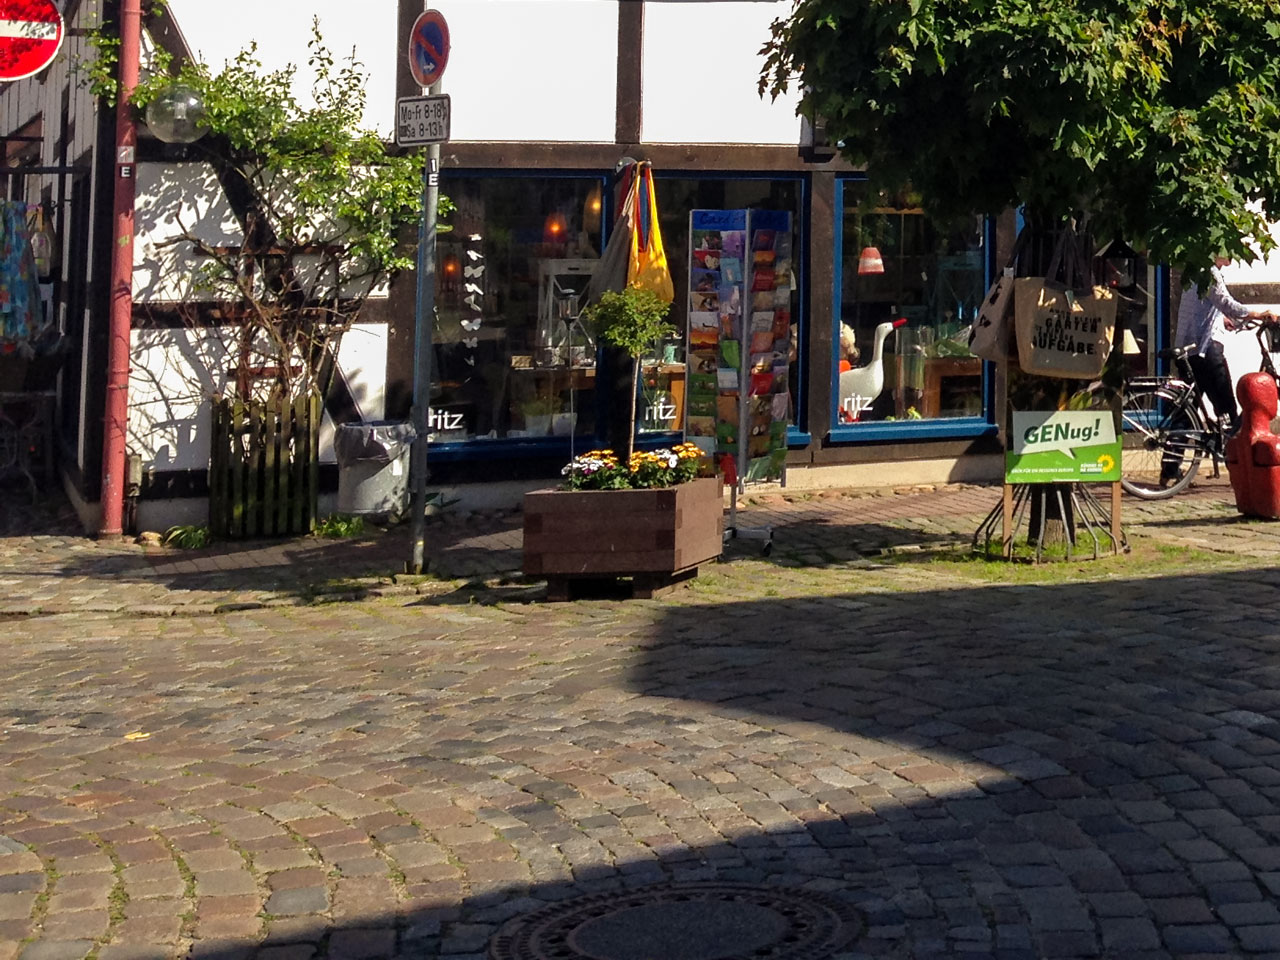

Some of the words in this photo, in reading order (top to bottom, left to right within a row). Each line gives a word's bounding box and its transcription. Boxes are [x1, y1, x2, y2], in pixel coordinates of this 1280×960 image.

[401, 105, 421, 121] Mo-Fr
[407, 124, 416, 137] Sa
[121, 166, 131, 177] E
[428, 174, 439, 186] E
[645, 401, 677, 420] ritz
[844, 393, 873, 411] ritz
[428, 407, 464, 429] ritz
[1023, 418, 1101, 444] GENug!
